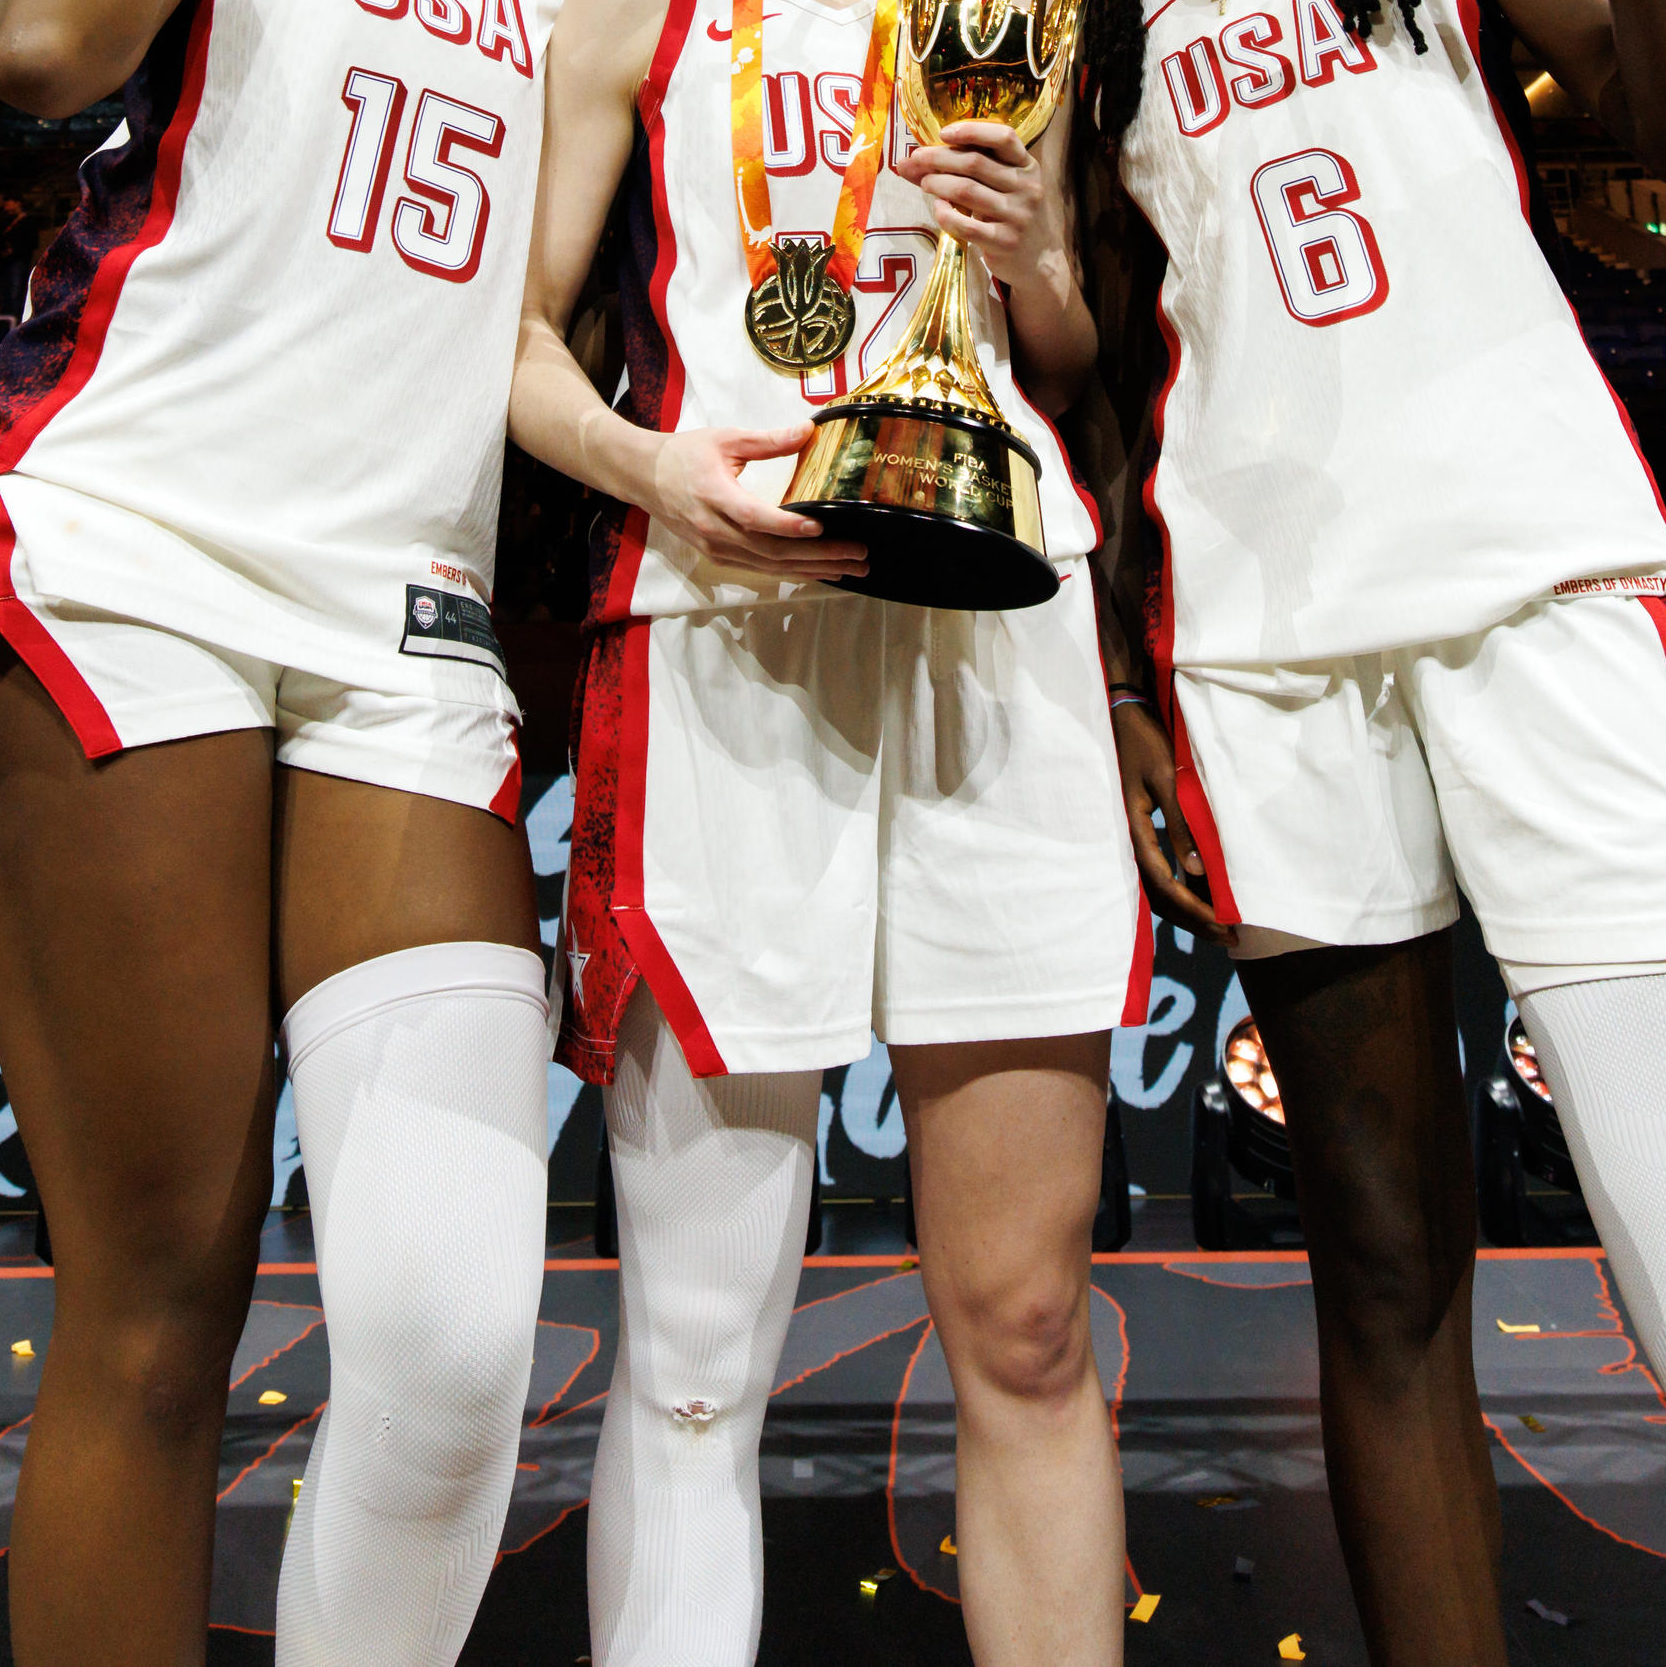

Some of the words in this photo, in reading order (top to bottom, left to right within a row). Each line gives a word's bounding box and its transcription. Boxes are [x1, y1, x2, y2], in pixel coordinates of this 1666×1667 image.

[761, 71, 923, 178] US
[327, 66, 506, 284] 15
[1250, 148, 1390, 328] 6
[775, 227, 938, 406] 2
[873, 452, 953, 474] WOMEN'S
[953, 452, 989, 474] FIBA
[920, 472, 981, 497] WORLD
[985, 491, 1015, 509] CUP
[431, 561, 462, 583] EMBERS
[1553, 578, 1602, 595] EMBERS
[1602, 577, 1617, 591] OF
